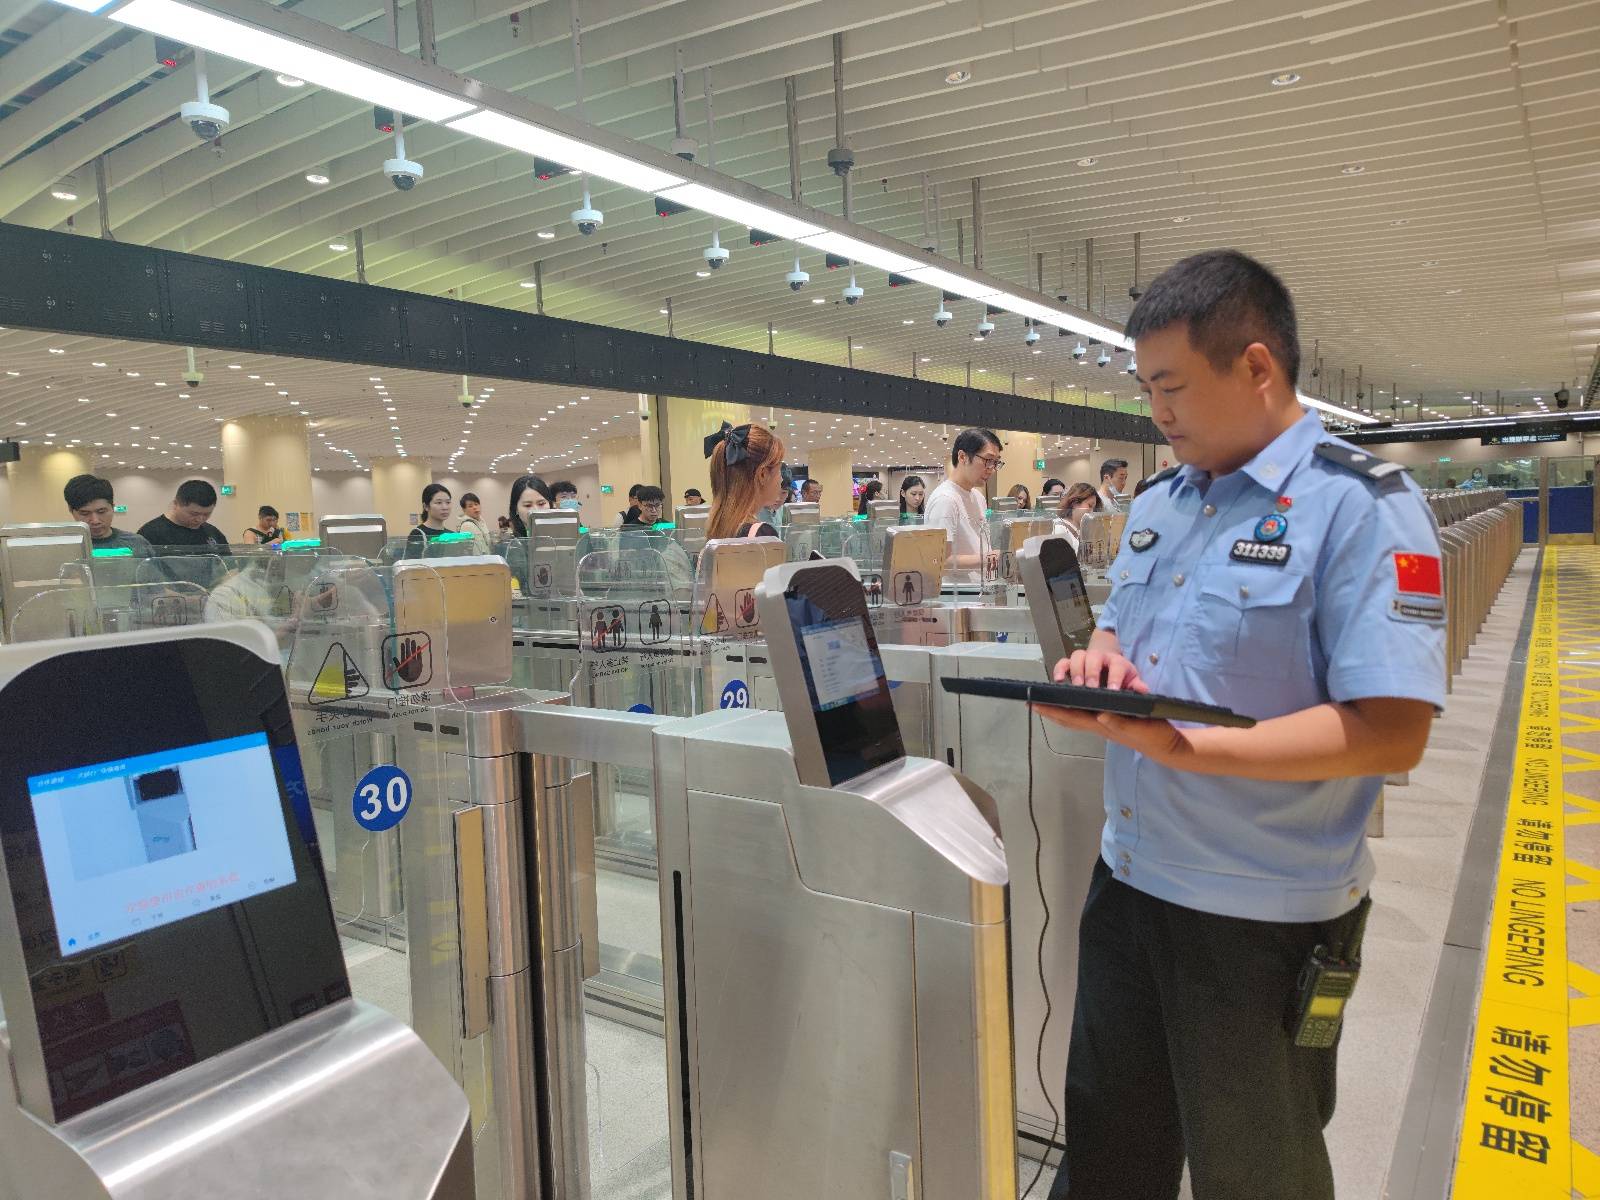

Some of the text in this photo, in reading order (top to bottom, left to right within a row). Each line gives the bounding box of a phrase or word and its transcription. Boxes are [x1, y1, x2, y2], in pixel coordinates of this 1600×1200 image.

[723, 687, 748, 709] 29
[360, 776, 408, 820] 30
[1521, 767, 1550, 806] LINGERING
[1511, 818, 1553, 866] 请勿停留
[1502, 878, 1547, 988] NO LINGERING
[1479, 1025, 1553, 1165] 请勿停留
